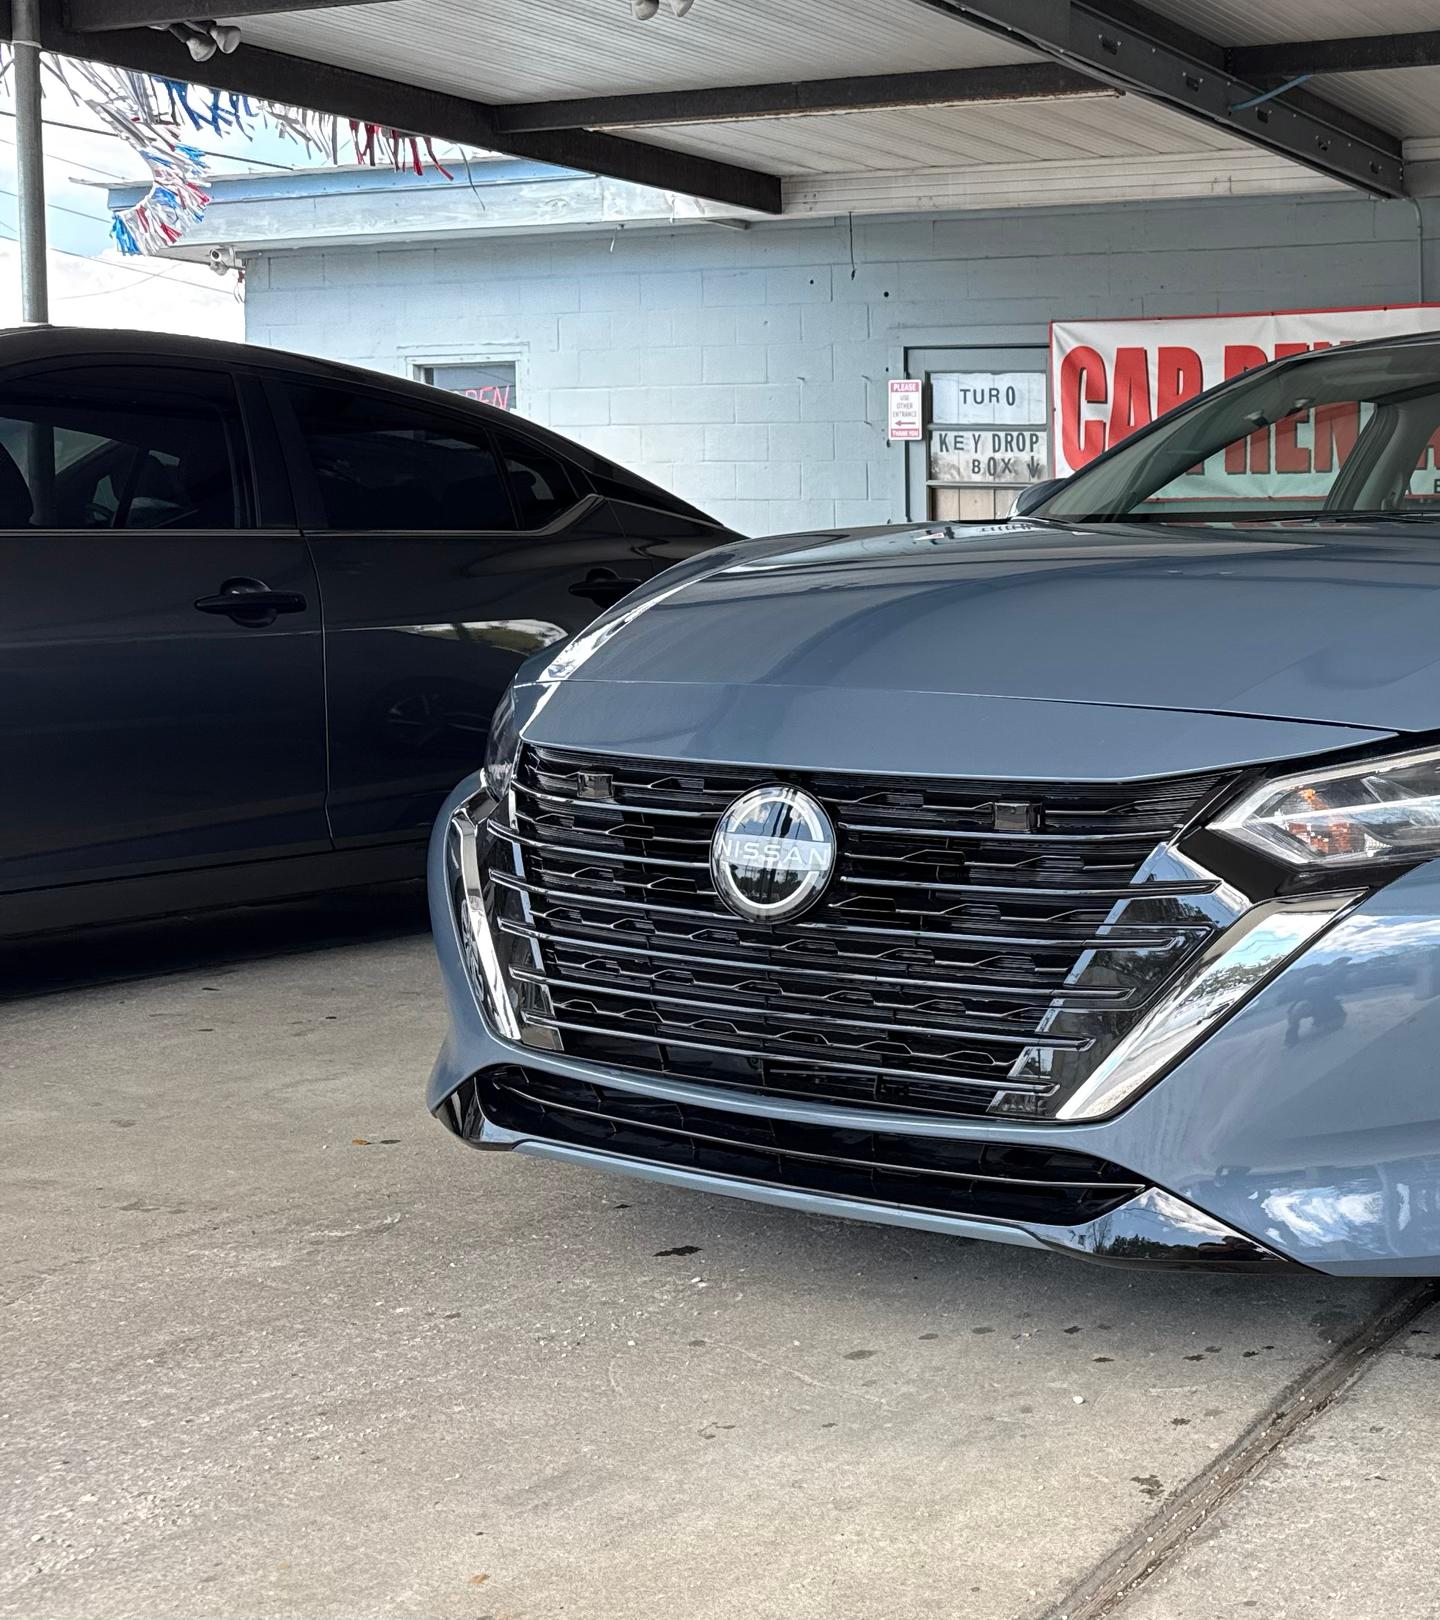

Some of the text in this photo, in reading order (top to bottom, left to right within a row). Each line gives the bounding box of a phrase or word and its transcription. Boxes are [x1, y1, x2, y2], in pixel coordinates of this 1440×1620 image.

[893, 383, 917, 391] PLEASE
[959, 385, 1016, 406] TURO
[892, 410, 917, 418] ENTRANCE
[939, 432, 1039, 453] KEY DROP
[972, 457, 1012, 476] BOX
[718, 832, 829, 867] NISSAN
